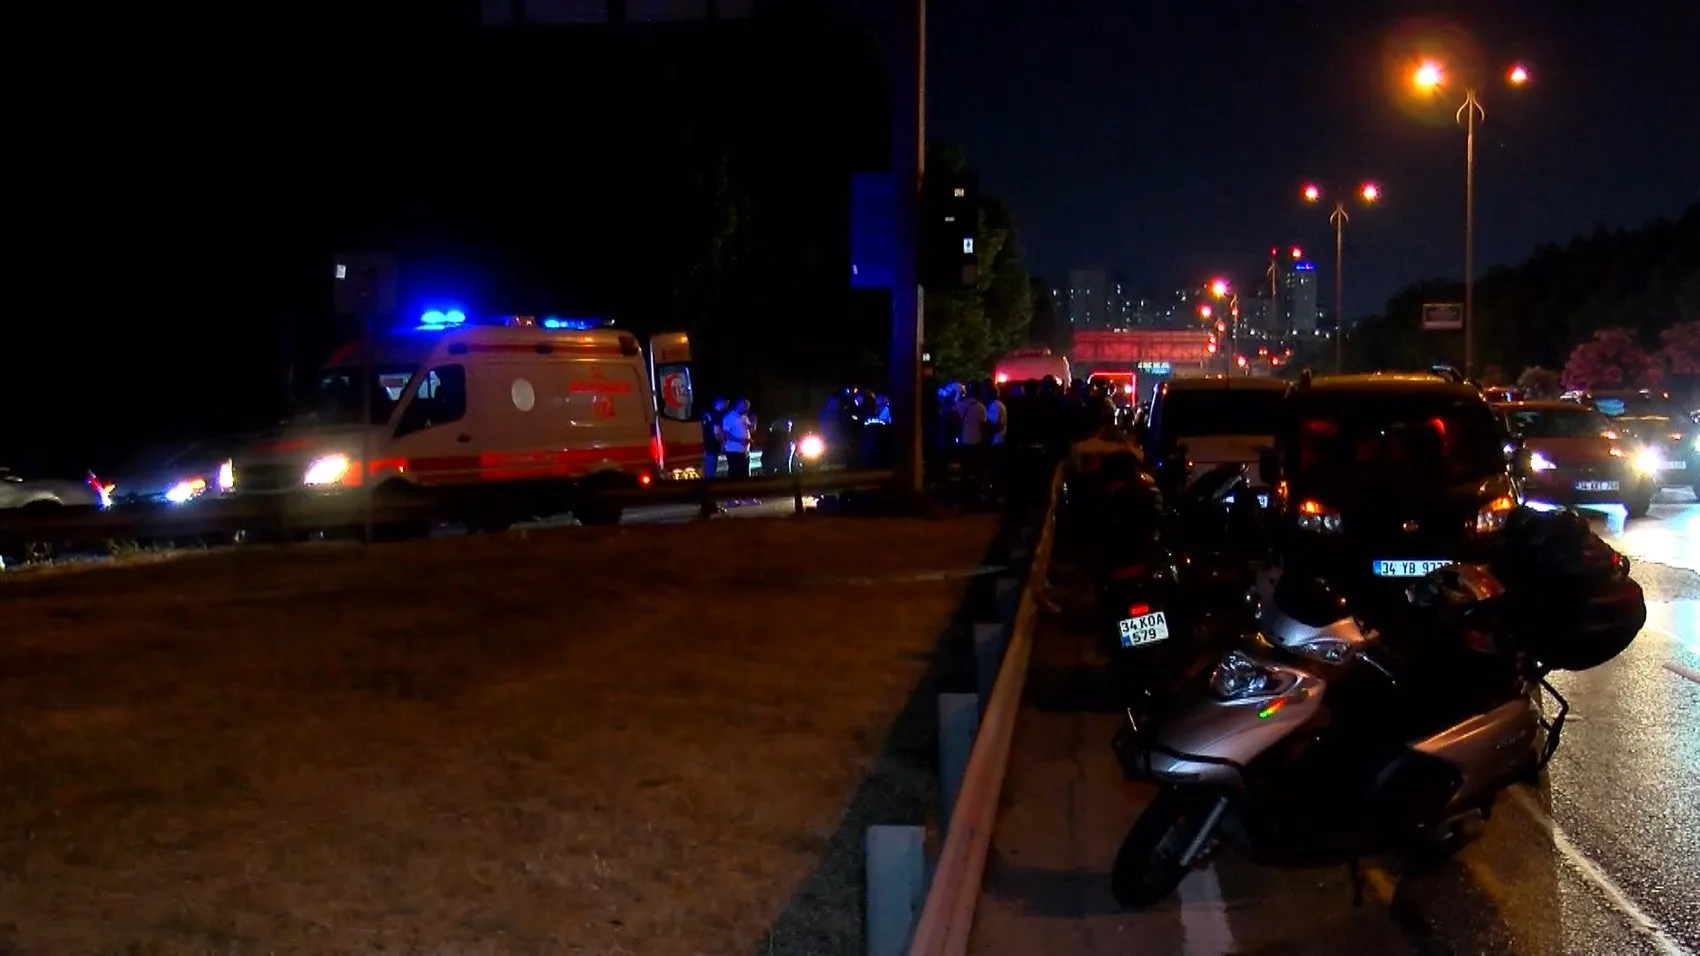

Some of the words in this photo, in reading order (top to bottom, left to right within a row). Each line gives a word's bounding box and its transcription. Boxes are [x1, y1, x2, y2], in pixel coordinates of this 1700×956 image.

[1382, 562, 1396, 574] 34
[1402, 562, 1416, 574] YB
[1422, 562, 1451, 574] 97
[1121, 620, 1137, 632] 34
[1132, 628, 1157, 643] 579
